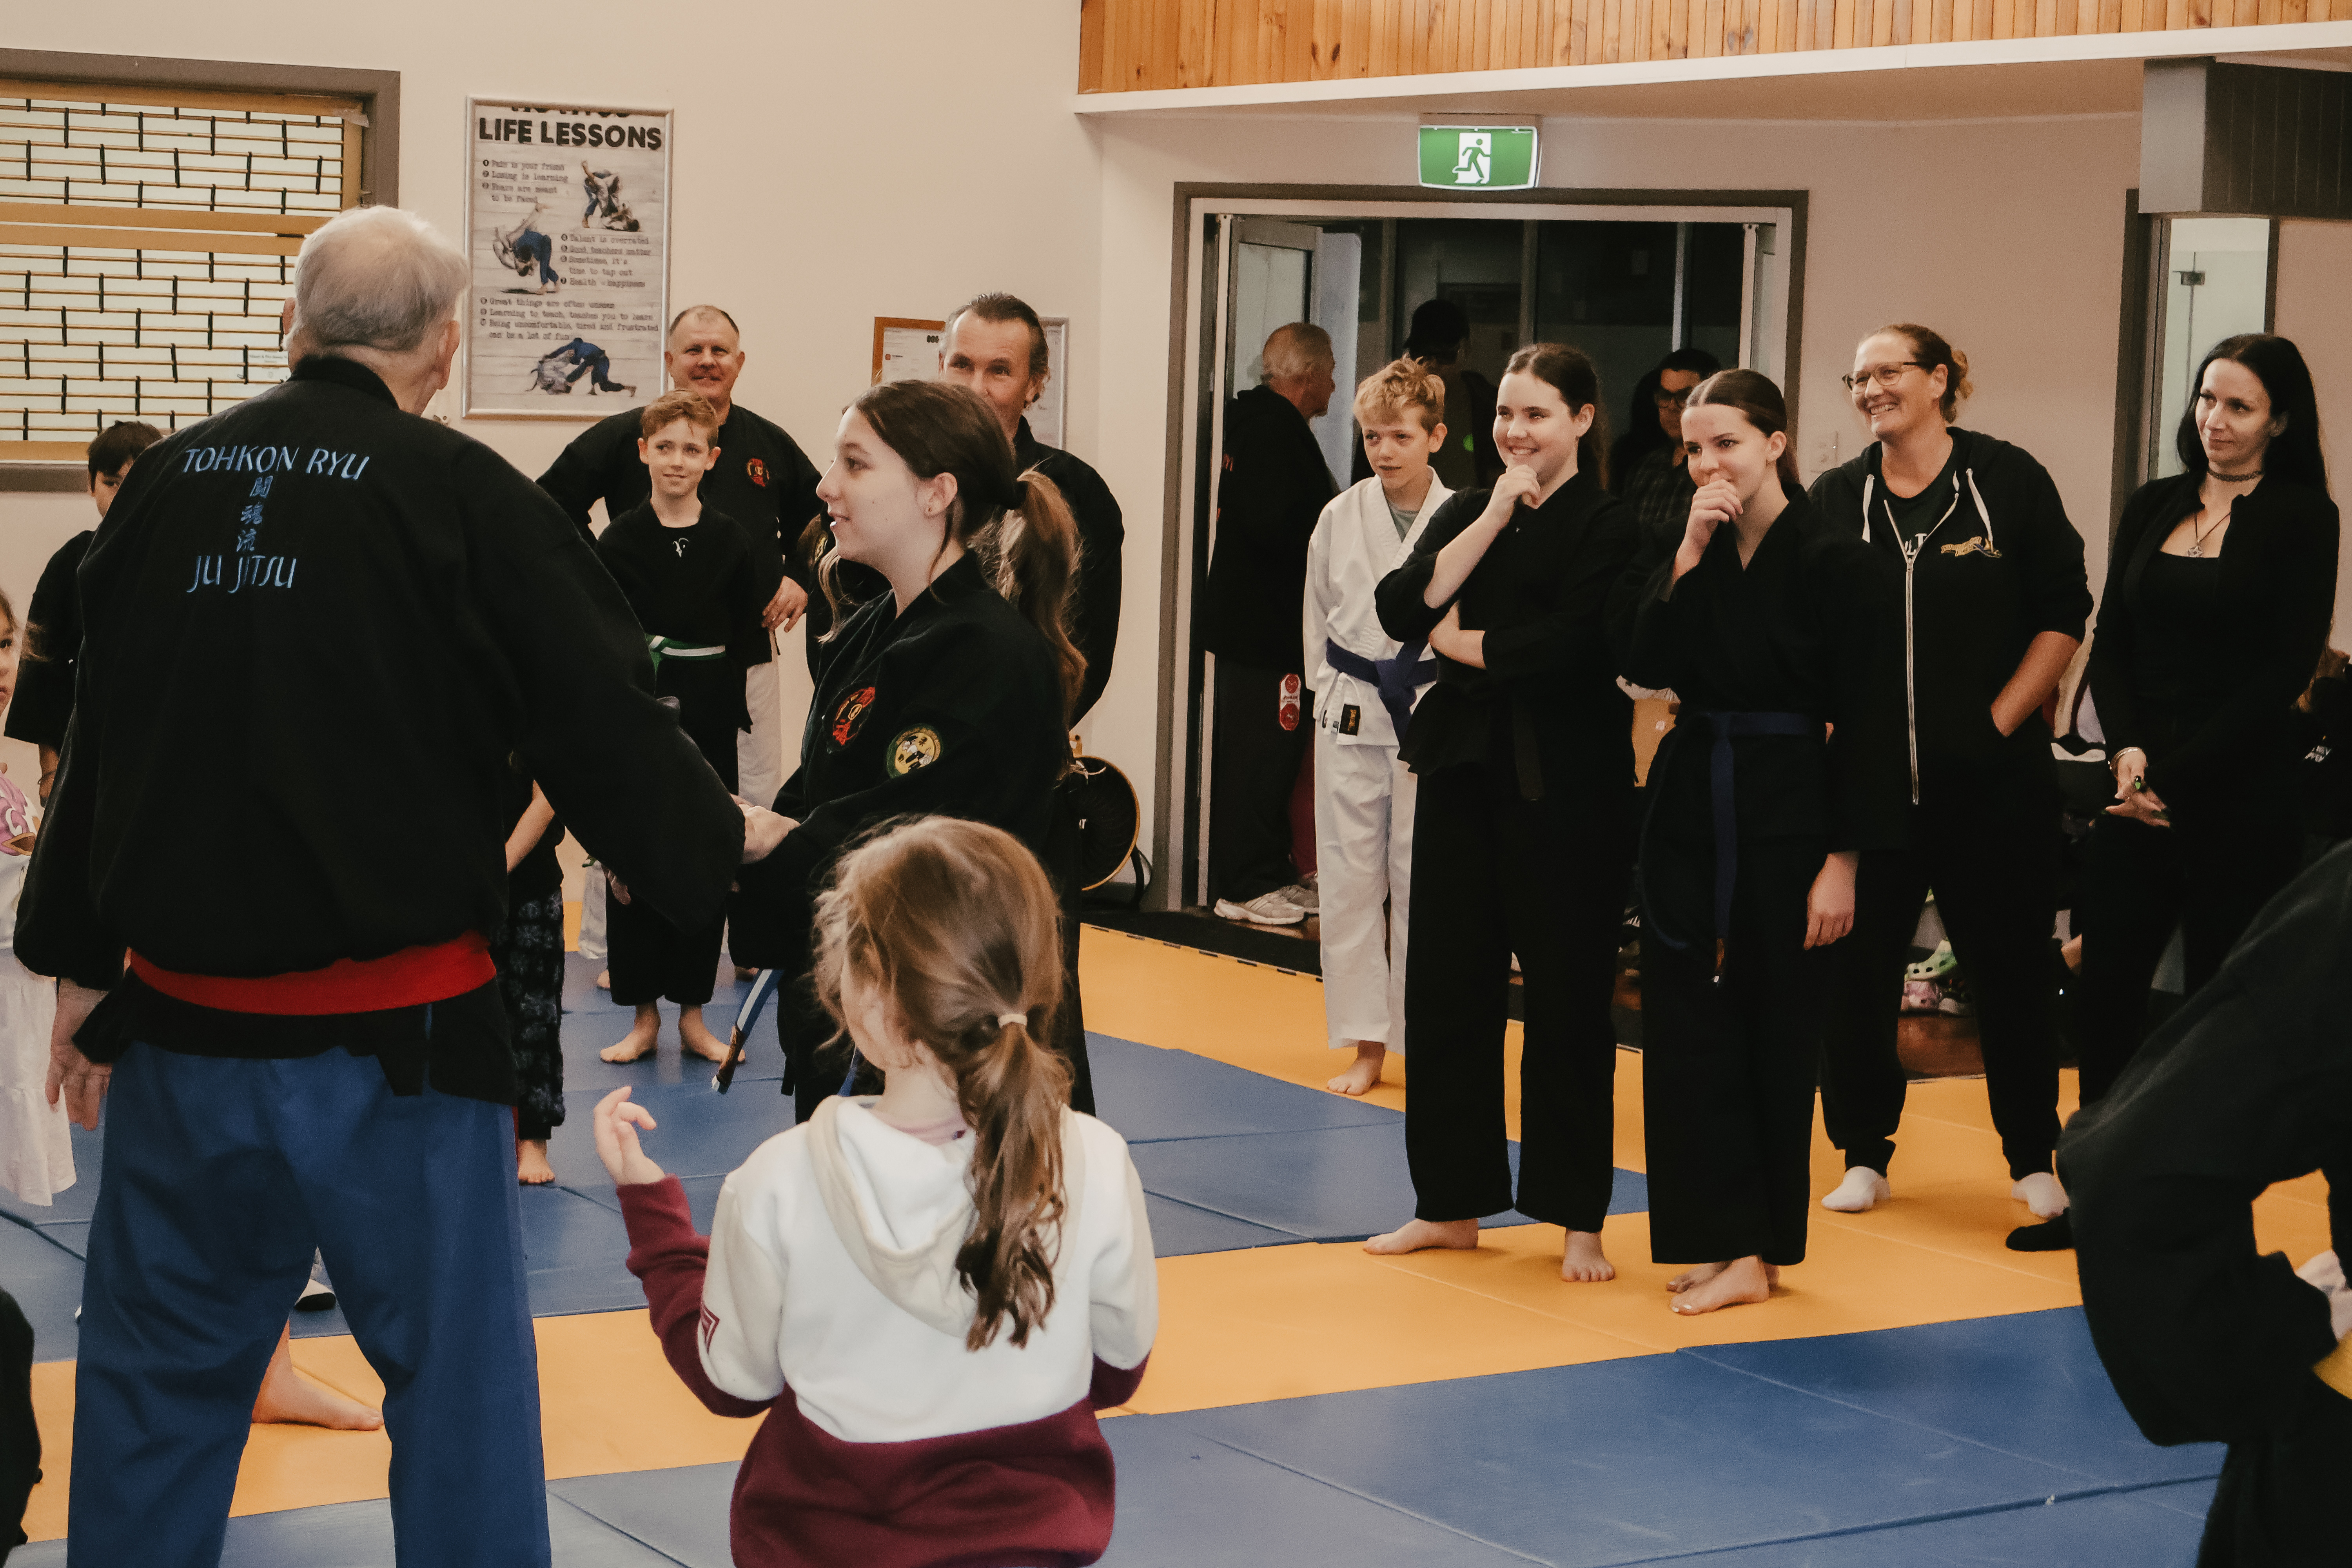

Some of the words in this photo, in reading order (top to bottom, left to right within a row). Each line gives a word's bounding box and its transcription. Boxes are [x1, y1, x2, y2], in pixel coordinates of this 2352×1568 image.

[479, 118, 532, 144] LIFE
[541, 121, 662, 151] LESSONS
[542, 163, 564, 171] friend
[492, 171, 517, 181] Losing
[534, 173, 568, 183] learning
[570, 234, 595, 242] Talent
[603, 269, 615, 277] tap
[570, 278, 596, 286] Health
[608, 280, 645, 288] happiness
[517, 299, 542, 308] things
[490, 309, 525, 318] Learning
[490, 319, 510, 328] Being
[617, 323, 658, 331] frustrated
[182, 445, 299, 473] TOHKON
[306, 448, 370, 480] RYU
[186, 555, 222, 593] JU
